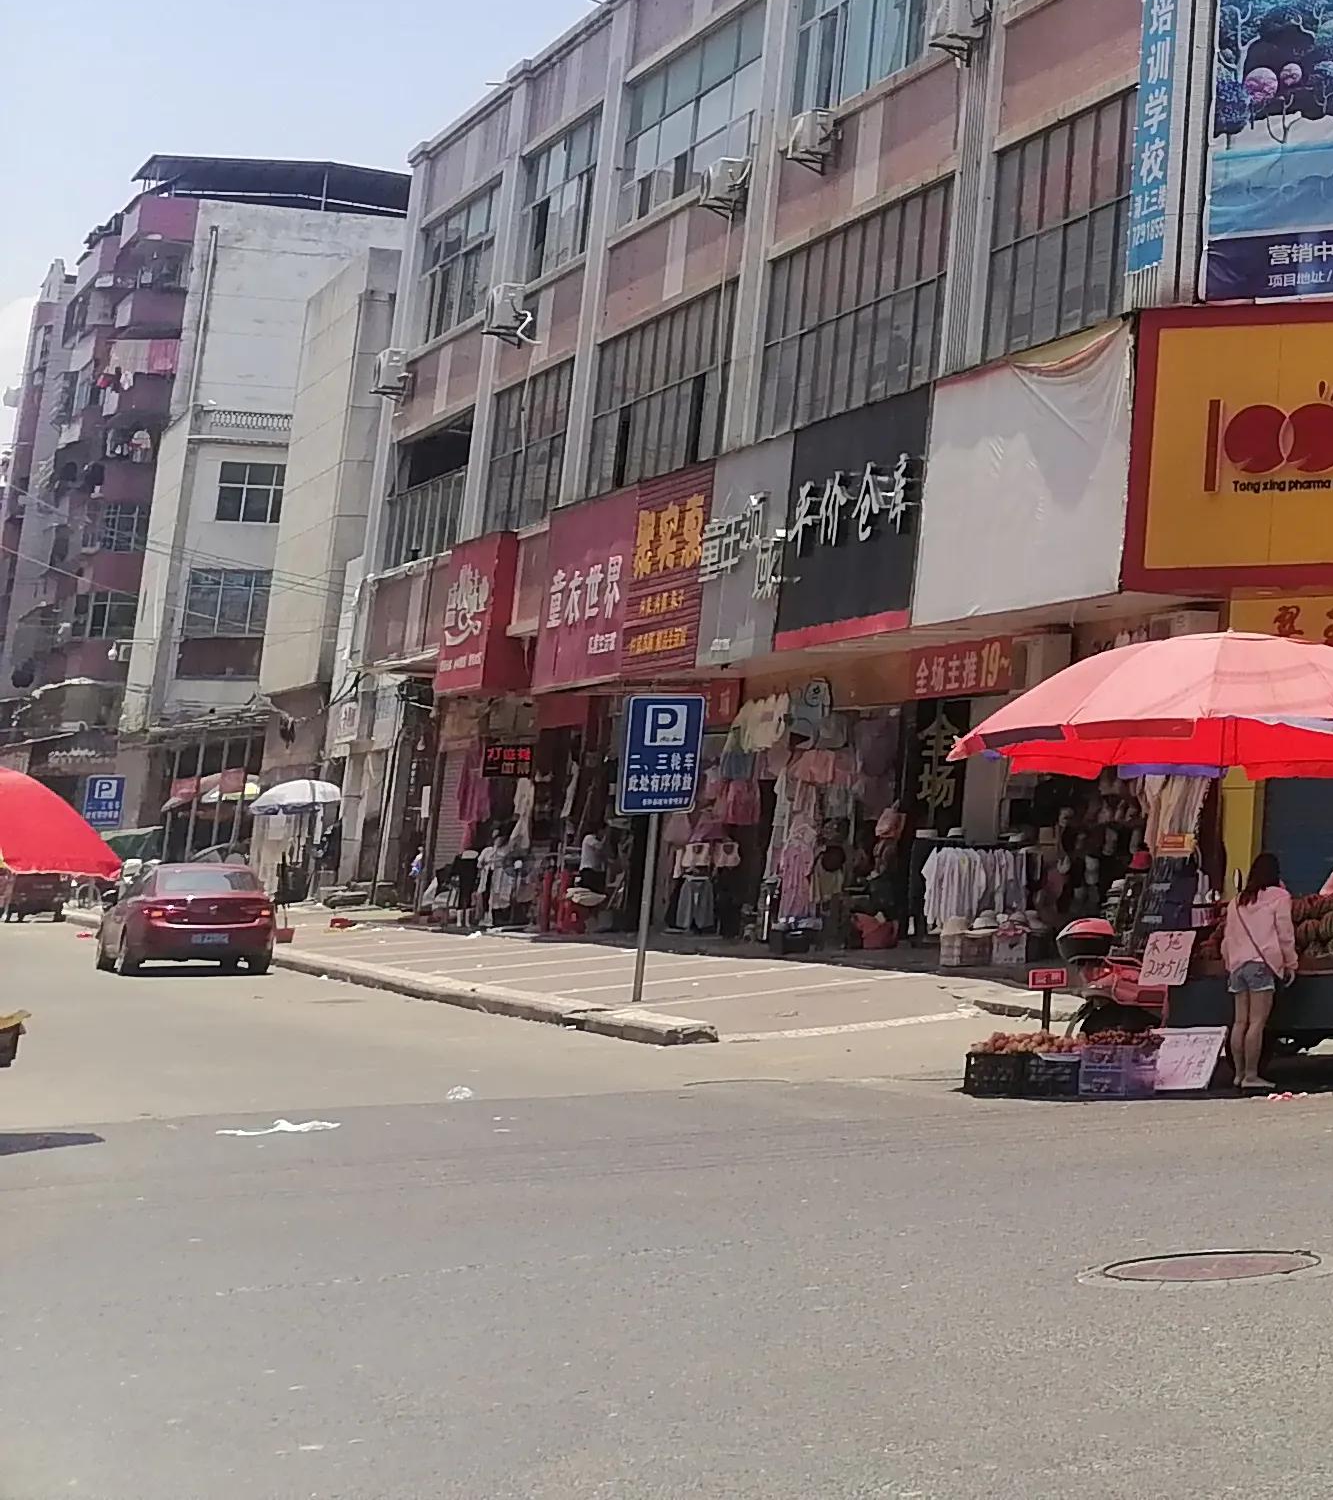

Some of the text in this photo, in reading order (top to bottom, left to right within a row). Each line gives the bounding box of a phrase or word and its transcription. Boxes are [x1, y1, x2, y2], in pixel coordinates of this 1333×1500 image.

[1231, 479, 1260, 494] Tong
[1261, 477, 1286, 493] xing
[787, 453, 908, 558] 平价仓库
[546, 554, 623, 629] 童衣世界
[649, 707, 679, 744] P
[629, 752, 695, 771] 二、三轮车
[917, 713, 960, 809] 全场
[97, 781, 113, 798] P
[627, 773, 693, 793] 此处有序停放
